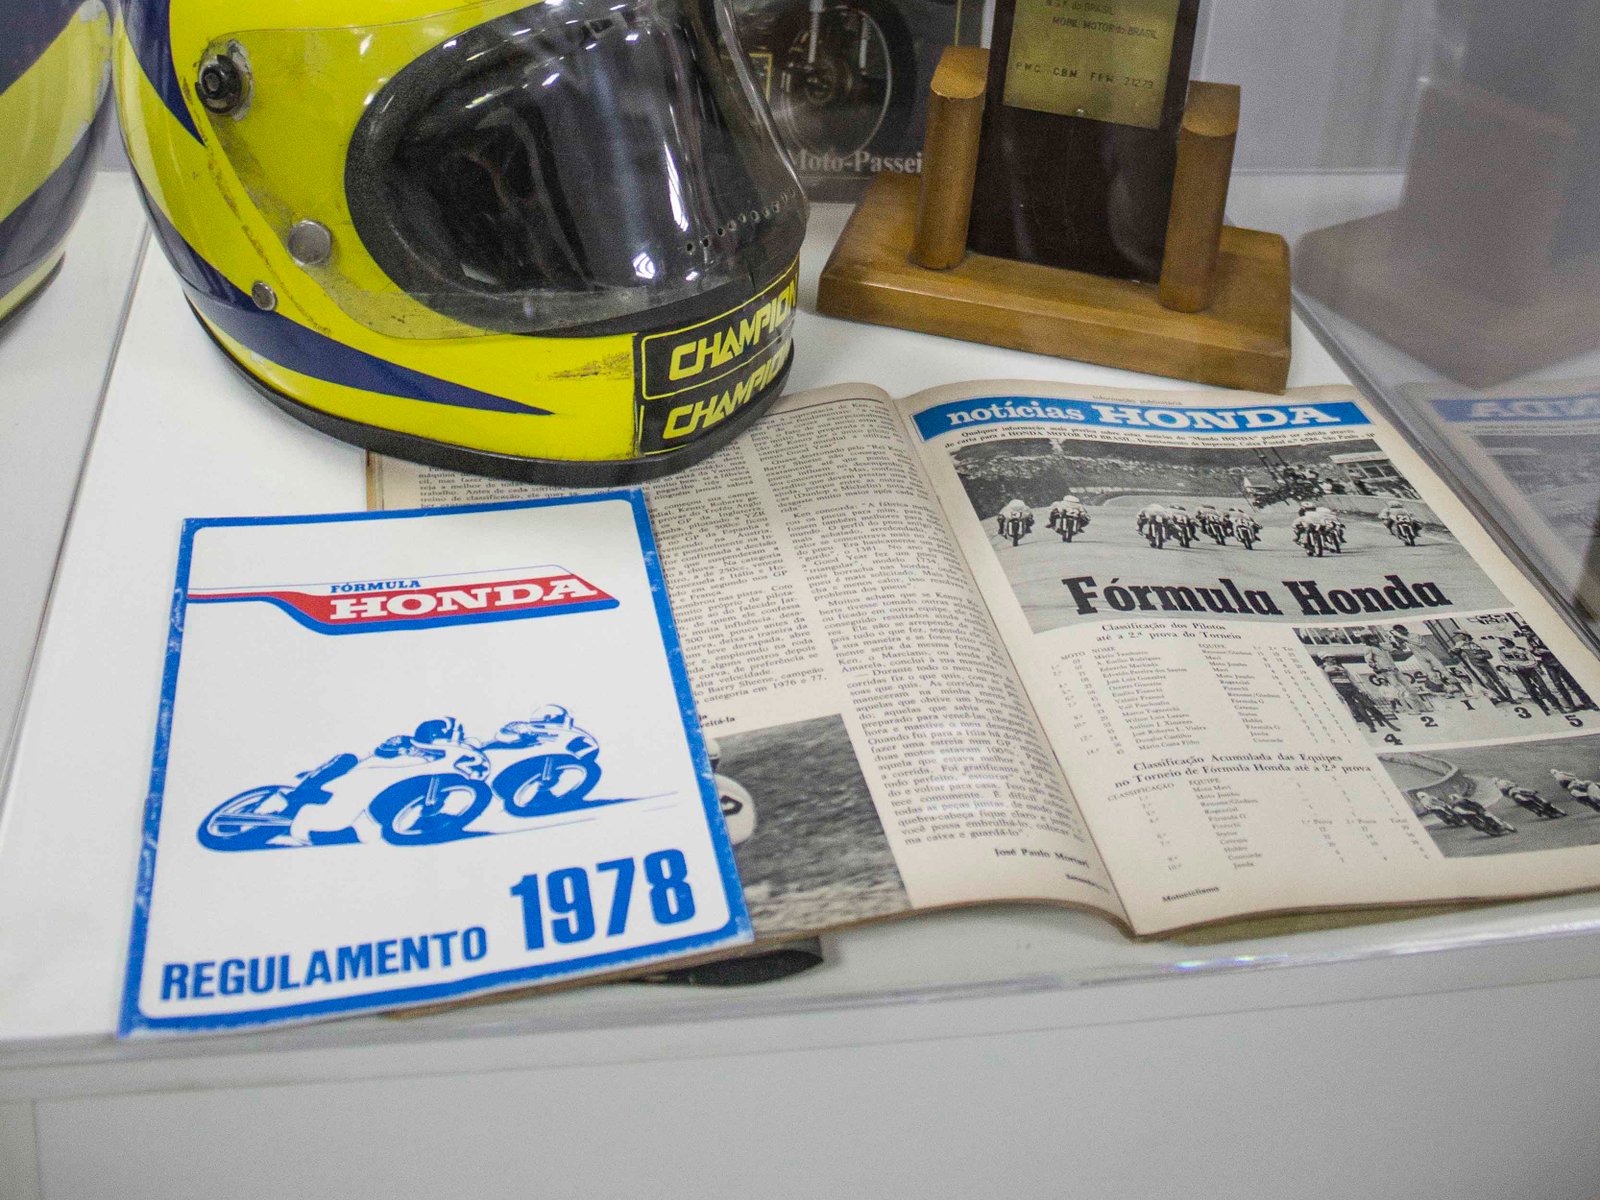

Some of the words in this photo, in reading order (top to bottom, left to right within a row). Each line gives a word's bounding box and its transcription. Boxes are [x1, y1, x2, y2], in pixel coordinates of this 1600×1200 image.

[946, 401, 1086, 426] notícias
[1091, 405, 1341, 431] HONDA
[957, 437, 977, 446] carta
[980, 434, 998, 443] para
[1046, 431, 1080, 439] MOTOR
[961, 428, 998, 438] Qualquer
[330, 579, 422, 595] FÓRMULA
[329, 573, 598, 622] HONDA
[1061, 575, 1284, 618] Fórmula
[1283, 574, 1453, 618] Honda
[1101, 622, 1166, 633] Classificação
[1170, 622, 1187, 630] dos
[1191, 622, 1226, 631] Pilotos
[1096, 634, 1113, 642] até
[1149, 633, 1178, 641] prova
[1182, 631, 1196, 639] do
[1199, 631, 1242, 640] Torneio
[708, 684, 735, 695] Barry
[773, 680, 797, 689] 1976
[1513, 706, 1532, 720] 3
[1420, 716, 1440, 728] 2
[1564, 714, 1584, 728] 5
[1383, 733, 1404, 746] 4
[1133, 755, 1205, 772] Classificação
[1211, 754, 1272, 762] Acumulada
[1277, 754, 1295, 762] das
[1300, 754, 1343, 763] Equipes
[1114, 778, 1130, 789] no
[1135, 771, 1181, 784] Torneio
[1185, 767, 1200, 776] de
[1202, 764, 1250, 774] Fórmula
[1254, 763, 1291, 772] Honda
[1294, 764, 1310, 772] até
[1342, 765, 1371, 774] prova
[994, 848, 1017, 857] José
[1021, 848, 1051, 858] Paulo
[509, 848, 697, 952] 1978
[160, 925, 488, 1002] REGULAMENTO
